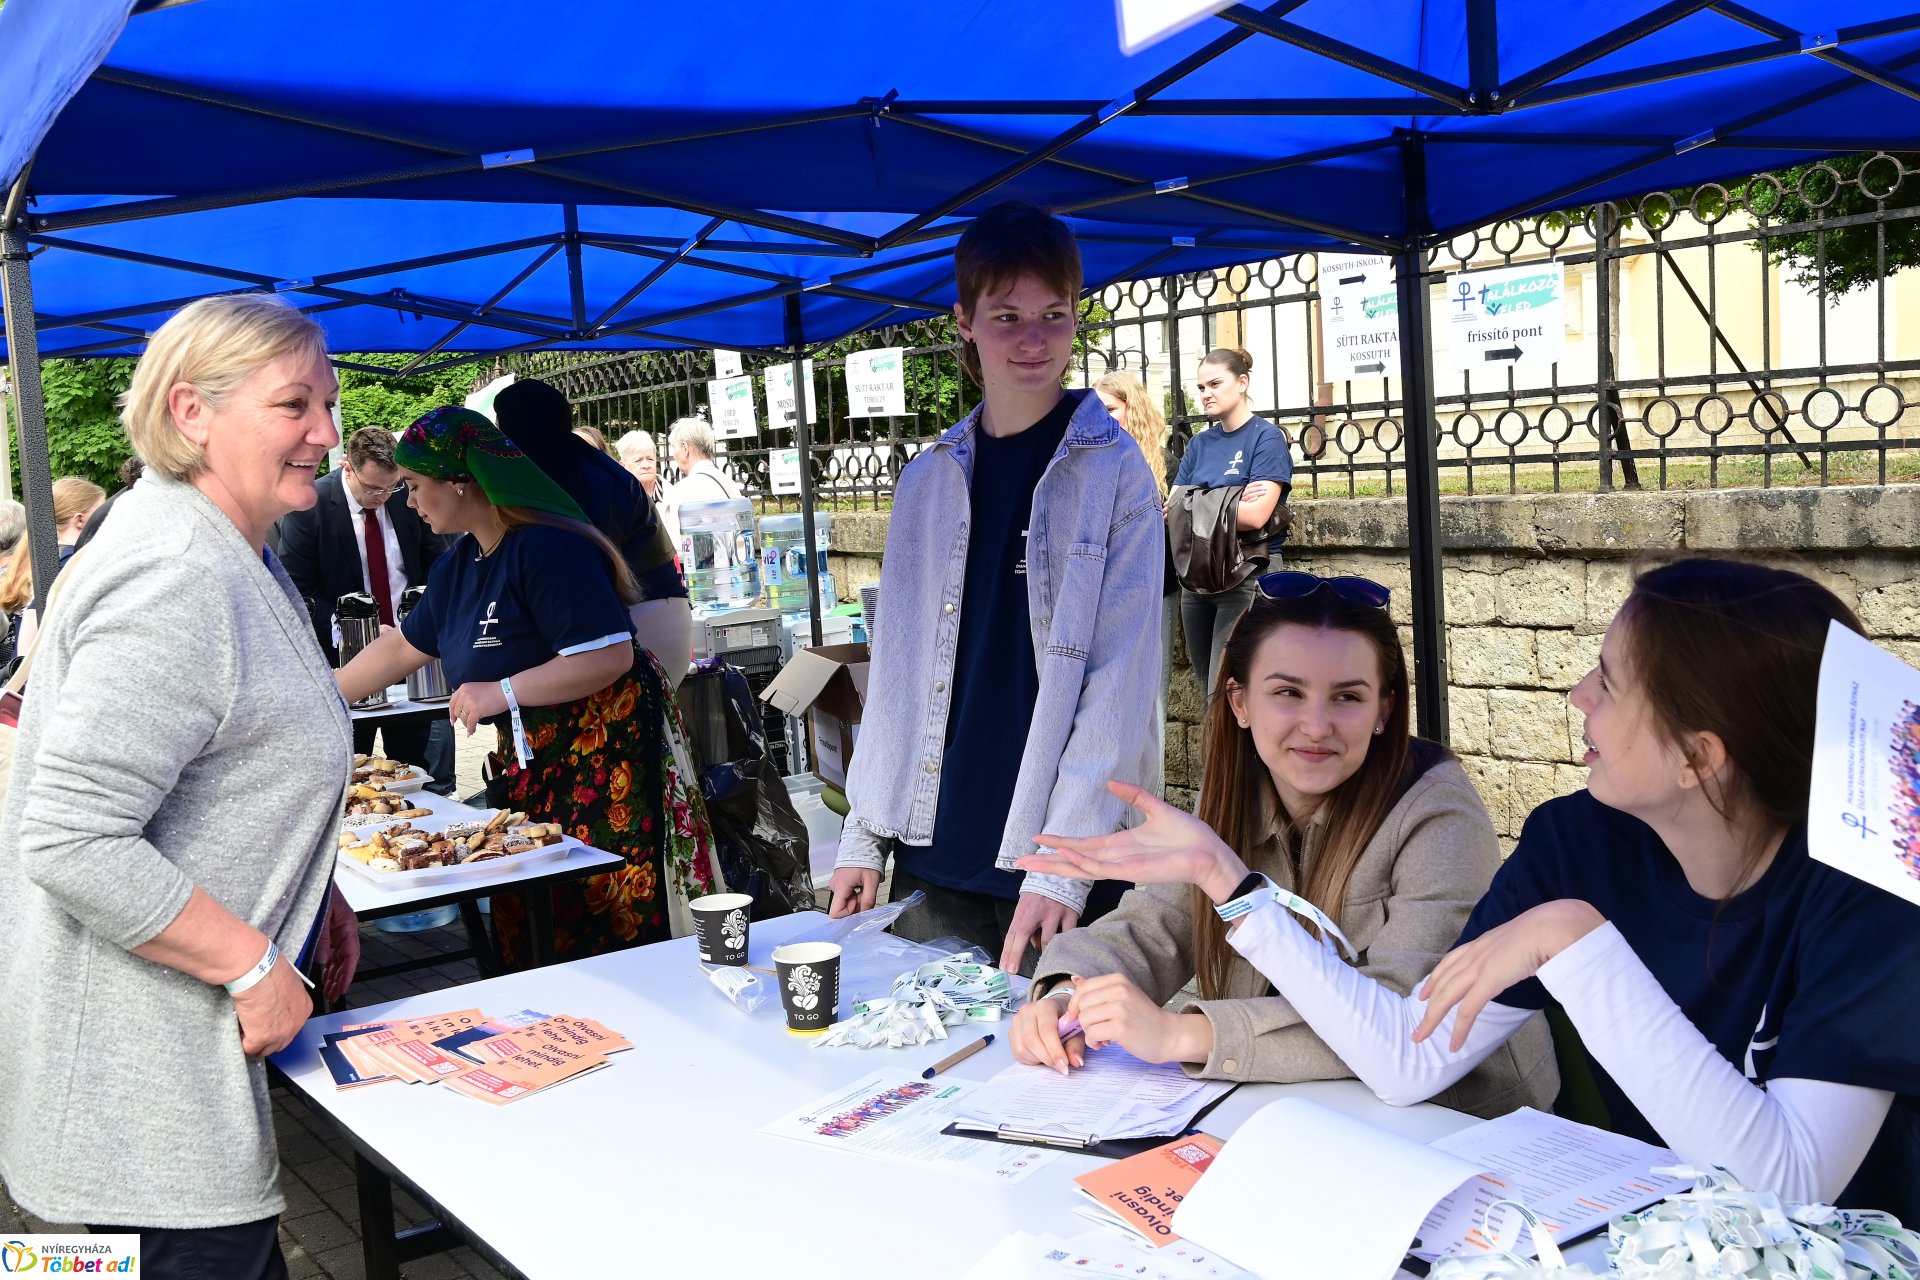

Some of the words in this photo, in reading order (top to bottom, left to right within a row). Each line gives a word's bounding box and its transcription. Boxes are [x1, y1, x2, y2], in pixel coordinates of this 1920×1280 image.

[1322, 257, 1384, 273] KOSSUTH-ISKOLA
[1336, 334, 1358, 348] SÜTI
[1361, 328, 1400, 345] RAKTÁ
[1468, 327, 1509, 342] frissítő
[1512, 325, 1543, 341] pont
[1350, 348, 1390, 361] KOSSUTH
[777, 398, 795, 409] MOSD
[725, 953, 736, 961] TO
[736, 952, 745, 960] GO
[793, 1013, 805, 1021] TO
[806, 1013, 819, 1021] GO
[556, 1025, 589, 1045] mindig
[573, 1021, 610, 1041] Olvasni
[526, 1049, 566, 1066] mindig
[542, 1044, 586, 1060] Olvasni
[512, 1054, 543, 1069] lehet.
[1133, 1185, 1176, 1218] indig
[1164, 1187, 1185, 1203] et.
[1109, 1191, 1171, 1236] Olvasni
